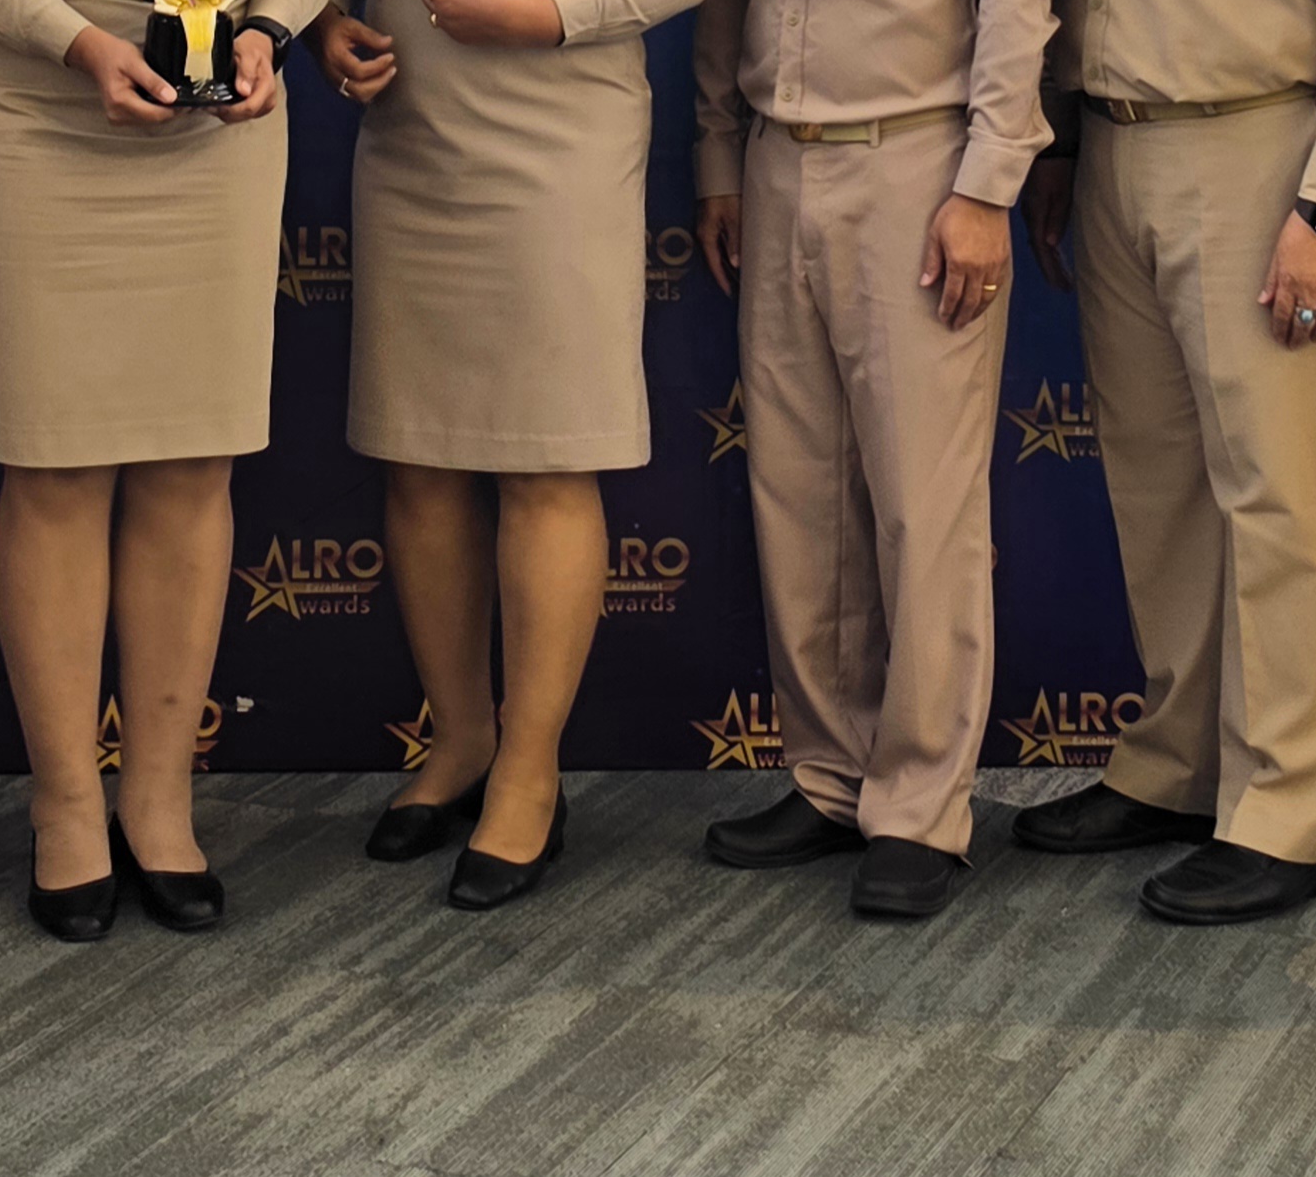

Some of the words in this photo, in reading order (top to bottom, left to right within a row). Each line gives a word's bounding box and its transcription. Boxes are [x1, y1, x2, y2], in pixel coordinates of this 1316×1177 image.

[233, 535, 383, 591] ALRO
[305, 582, 358, 593] Excellent
[1000, 686, 1145, 742] ALRO
[1066, 750, 1109, 765] war
